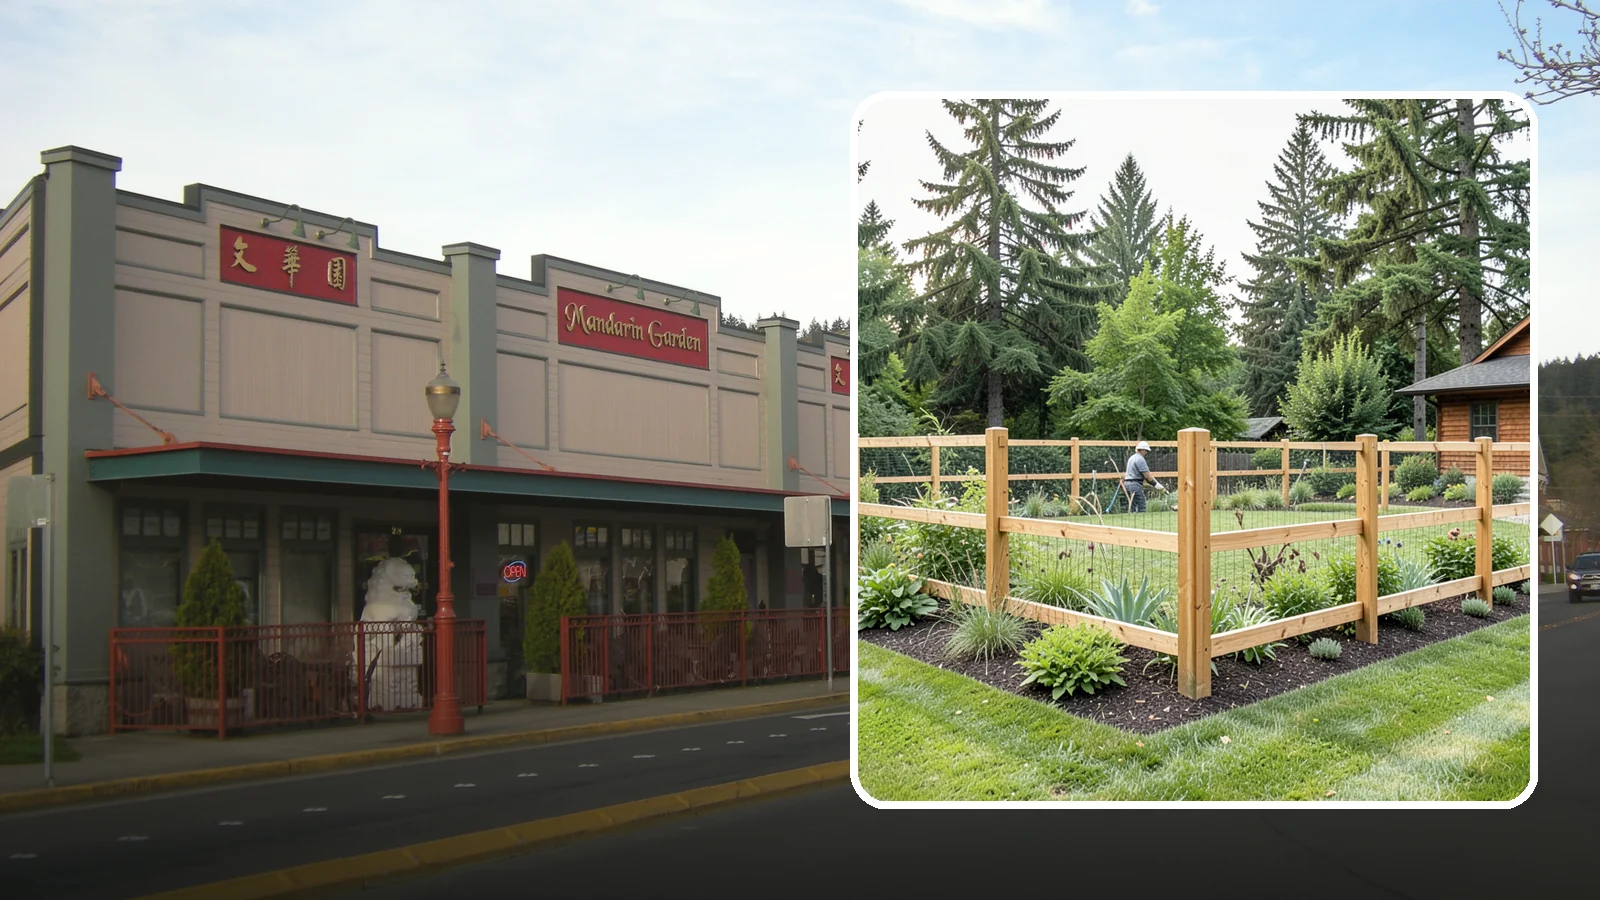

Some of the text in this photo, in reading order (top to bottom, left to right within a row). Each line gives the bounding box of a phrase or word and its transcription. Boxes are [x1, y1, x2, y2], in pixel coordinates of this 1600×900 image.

[231, 235, 346, 291] 文華園
[564, 302, 702, 352] Mandarin Garden
[503, 565, 527, 578] OPEN
